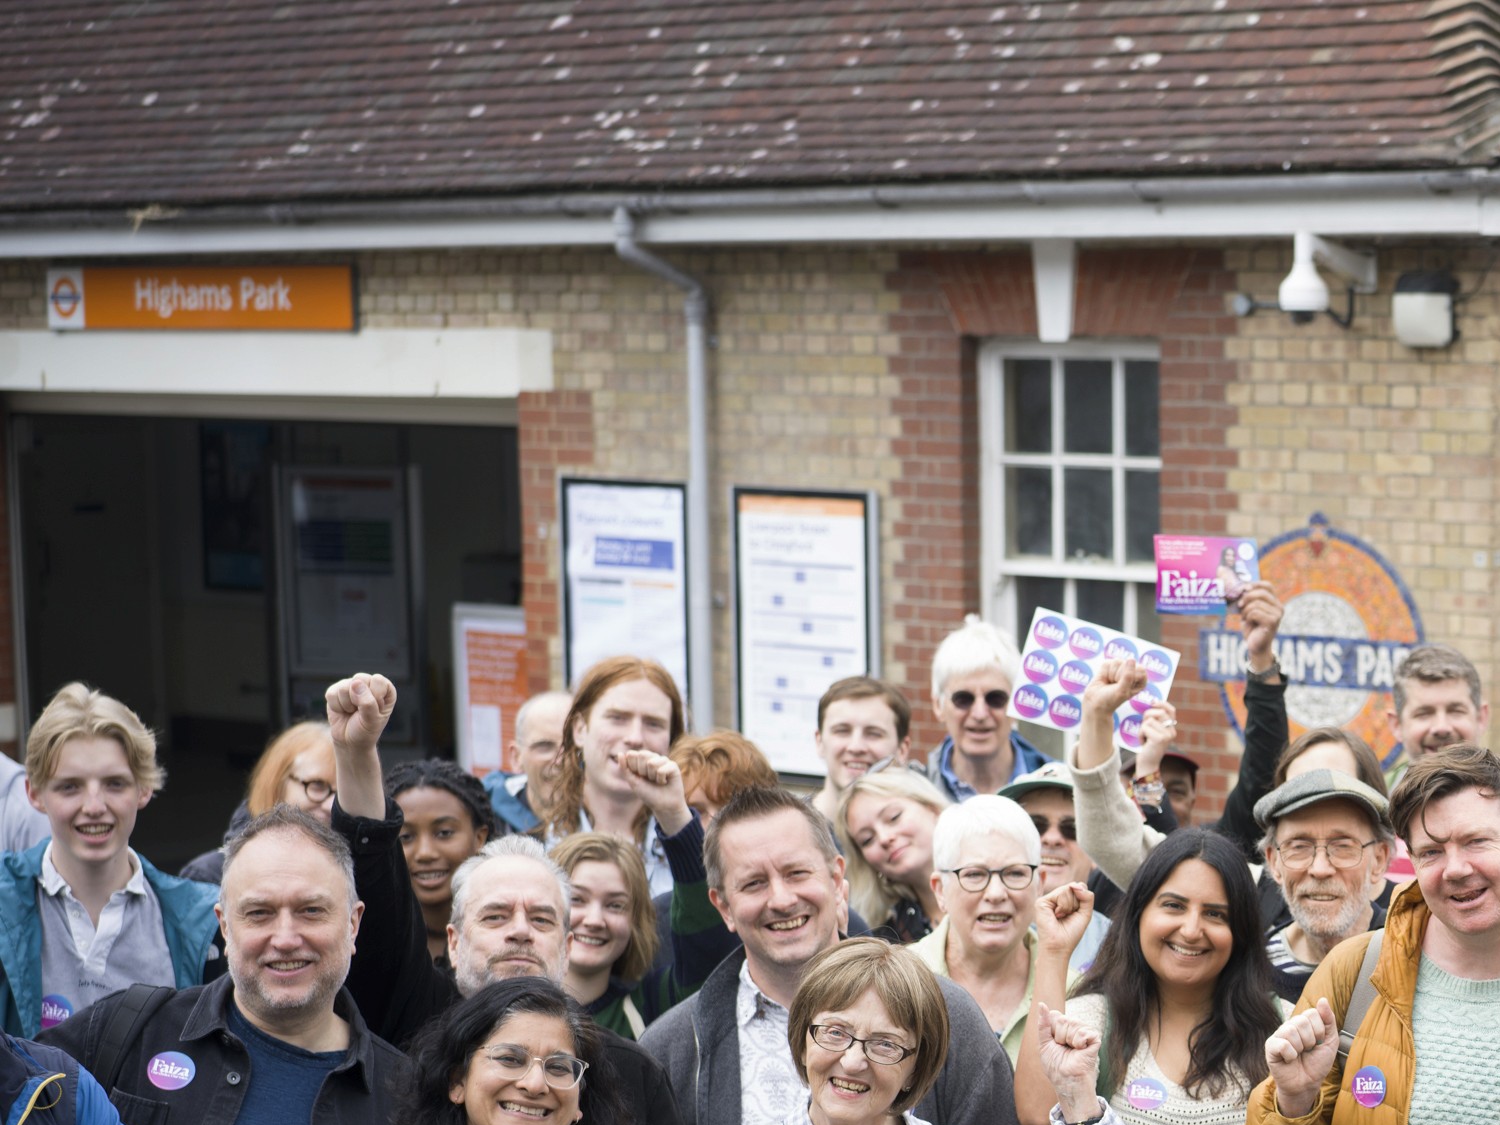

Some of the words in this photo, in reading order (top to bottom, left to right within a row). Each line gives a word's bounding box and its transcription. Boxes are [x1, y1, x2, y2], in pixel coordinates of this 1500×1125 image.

[135, 278, 232, 318] Highams
[239, 277, 292, 311] Park
[1160, 570, 1225, 597] Faiza
[1208, 633, 1342, 683] HIAMS
[152, 1058, 190, 1076] Faiza
[1131, 1084, 1163, 1098] Faiza
[1356, 1077, 1383, 1090] Faiza
